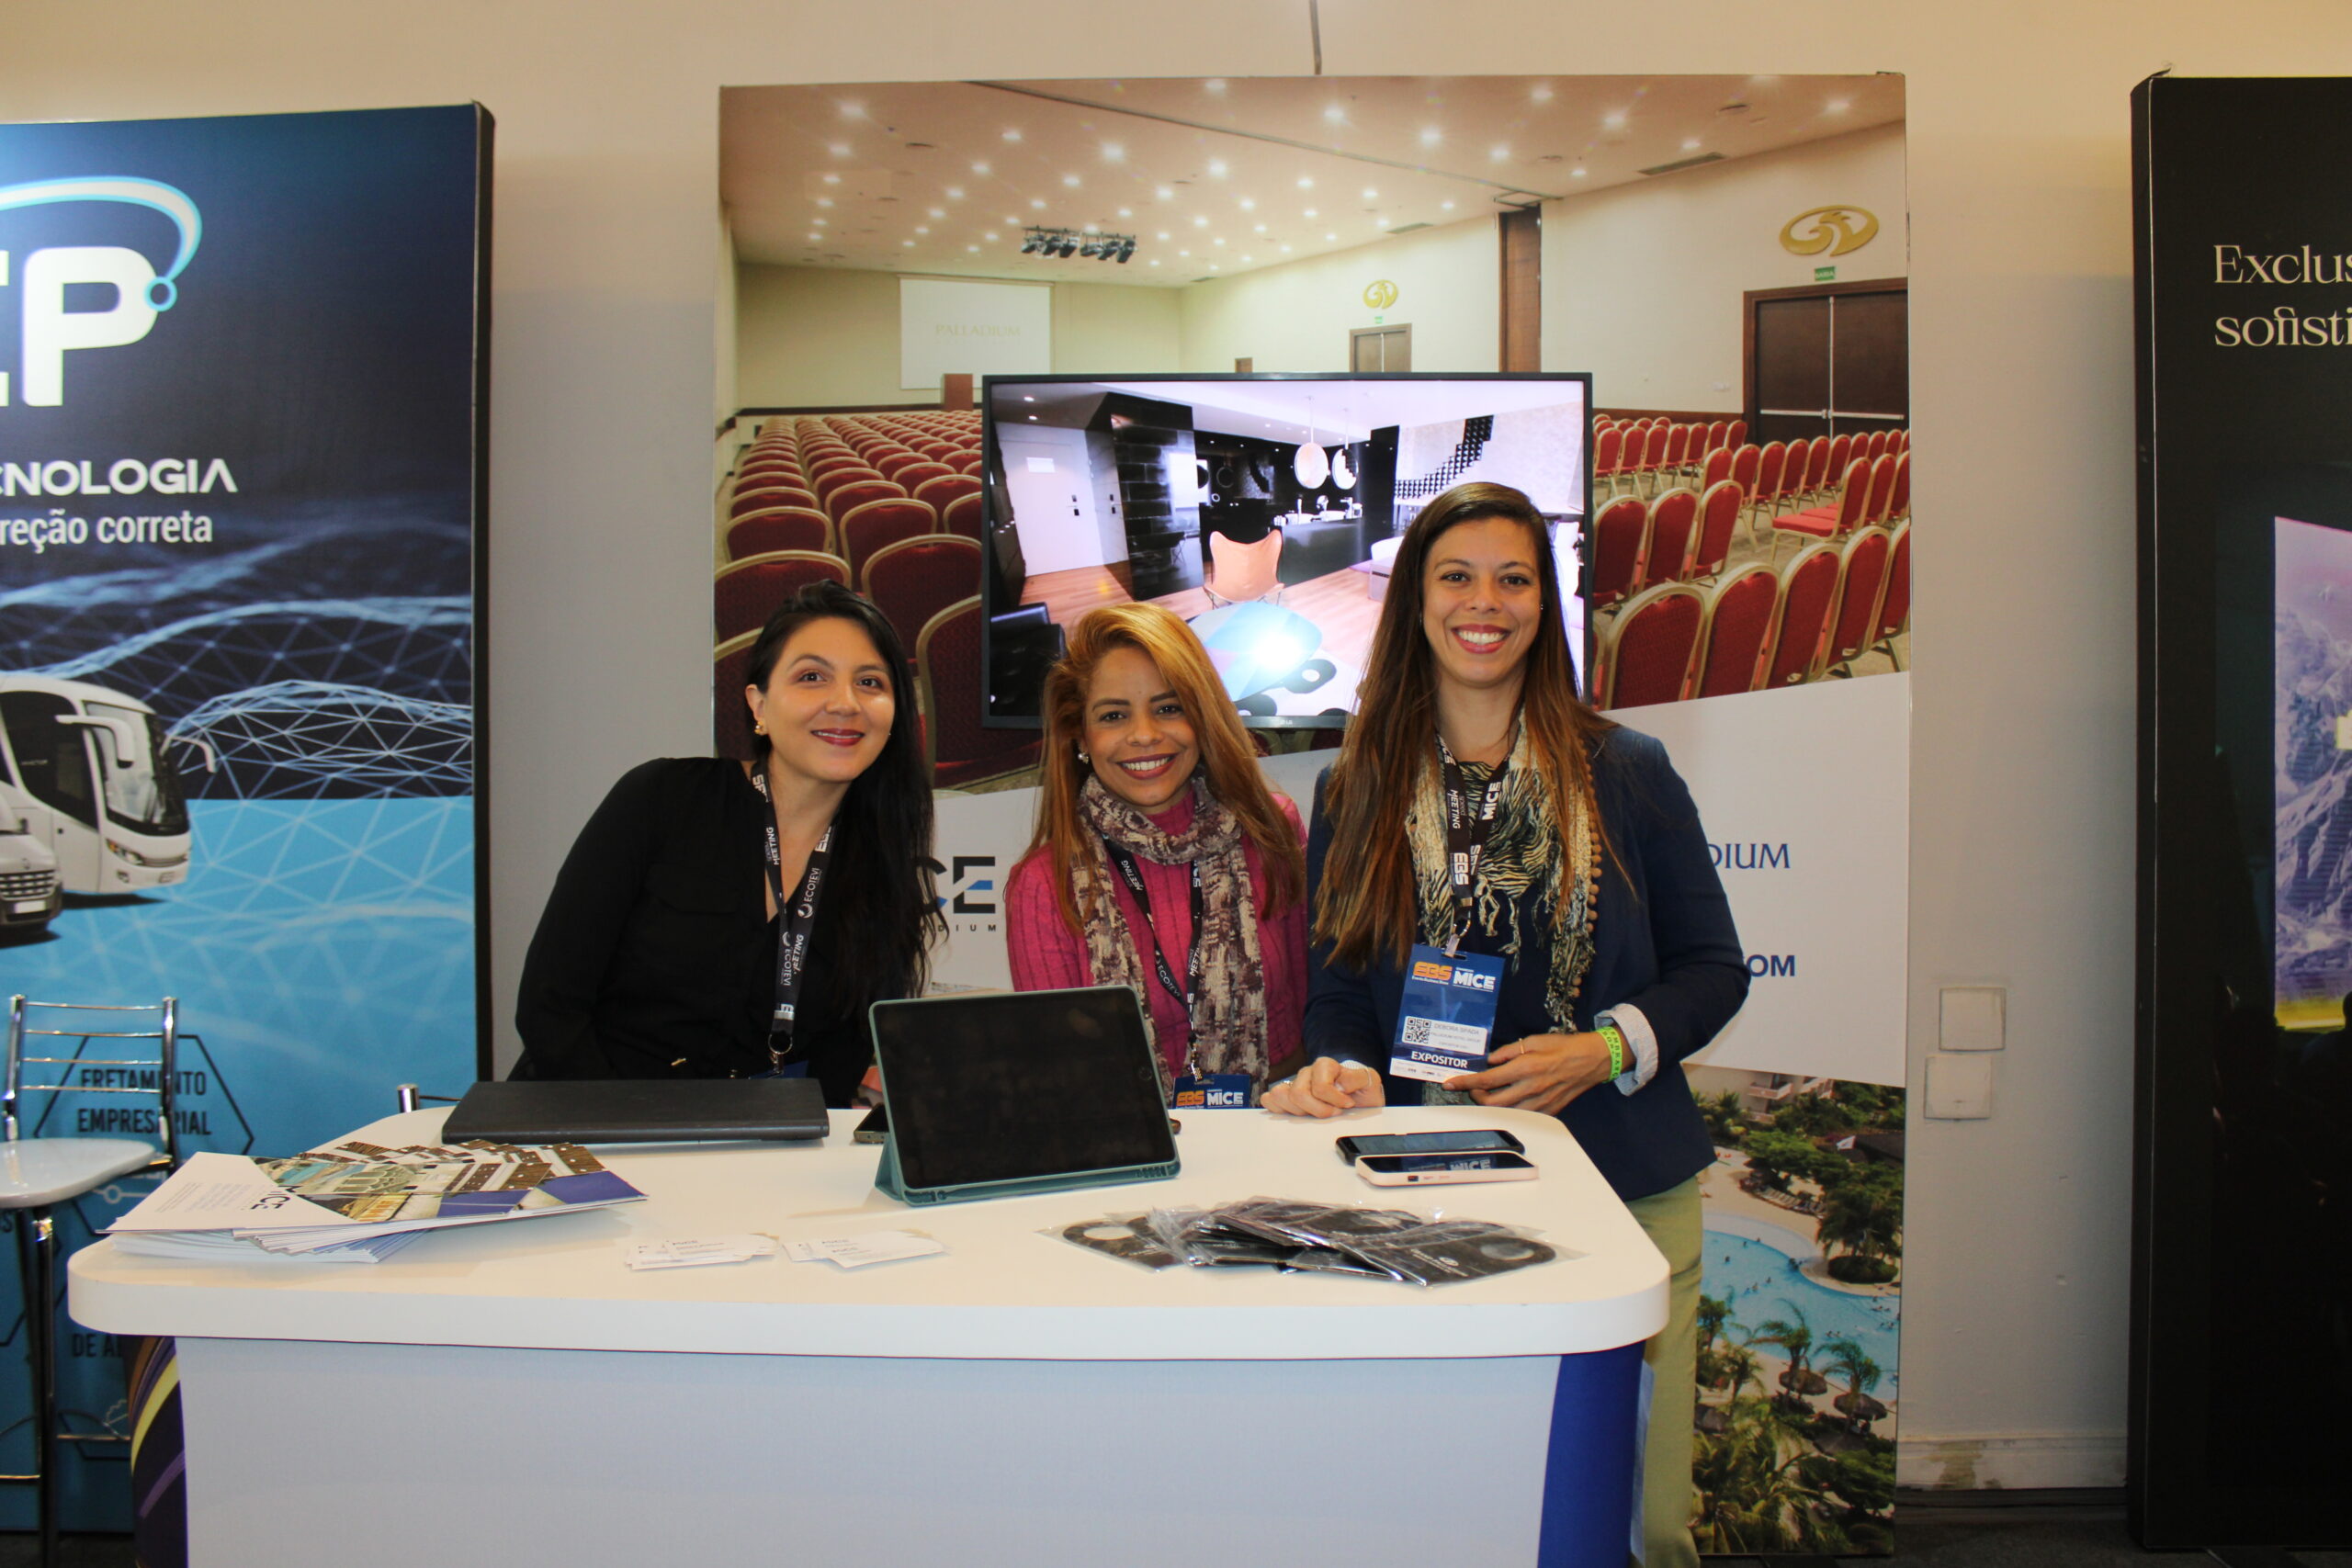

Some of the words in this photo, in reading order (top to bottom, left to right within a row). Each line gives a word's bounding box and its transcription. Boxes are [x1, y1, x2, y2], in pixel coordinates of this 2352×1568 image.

[0, 458, 238, 497] NOLOGIA
[96, 510, 213, 544] correta
[1448, 789, 1461, 829] MEETING
[1482, 782, 1502, 820] MICE
[765, 827, 780, 865] MEETING
[803, 867, 820, 902] ECOTEVI
[1121, 860, 1144, 891] MEETING
[1453, 852, 1469, 886] EBS
[1413, 961, 1453, 981] EBS
[1453, 970, 1496, 990] MICE
[1746, 953, 1795, 977] OM
[1411, 1051, 1467, 1069] EXPOSITOR
[1176, 1090, 1205, 1107] EBS
[1207, 1091, 1243, 1106] MICE
[72, 1334, 96, 1358] DE
